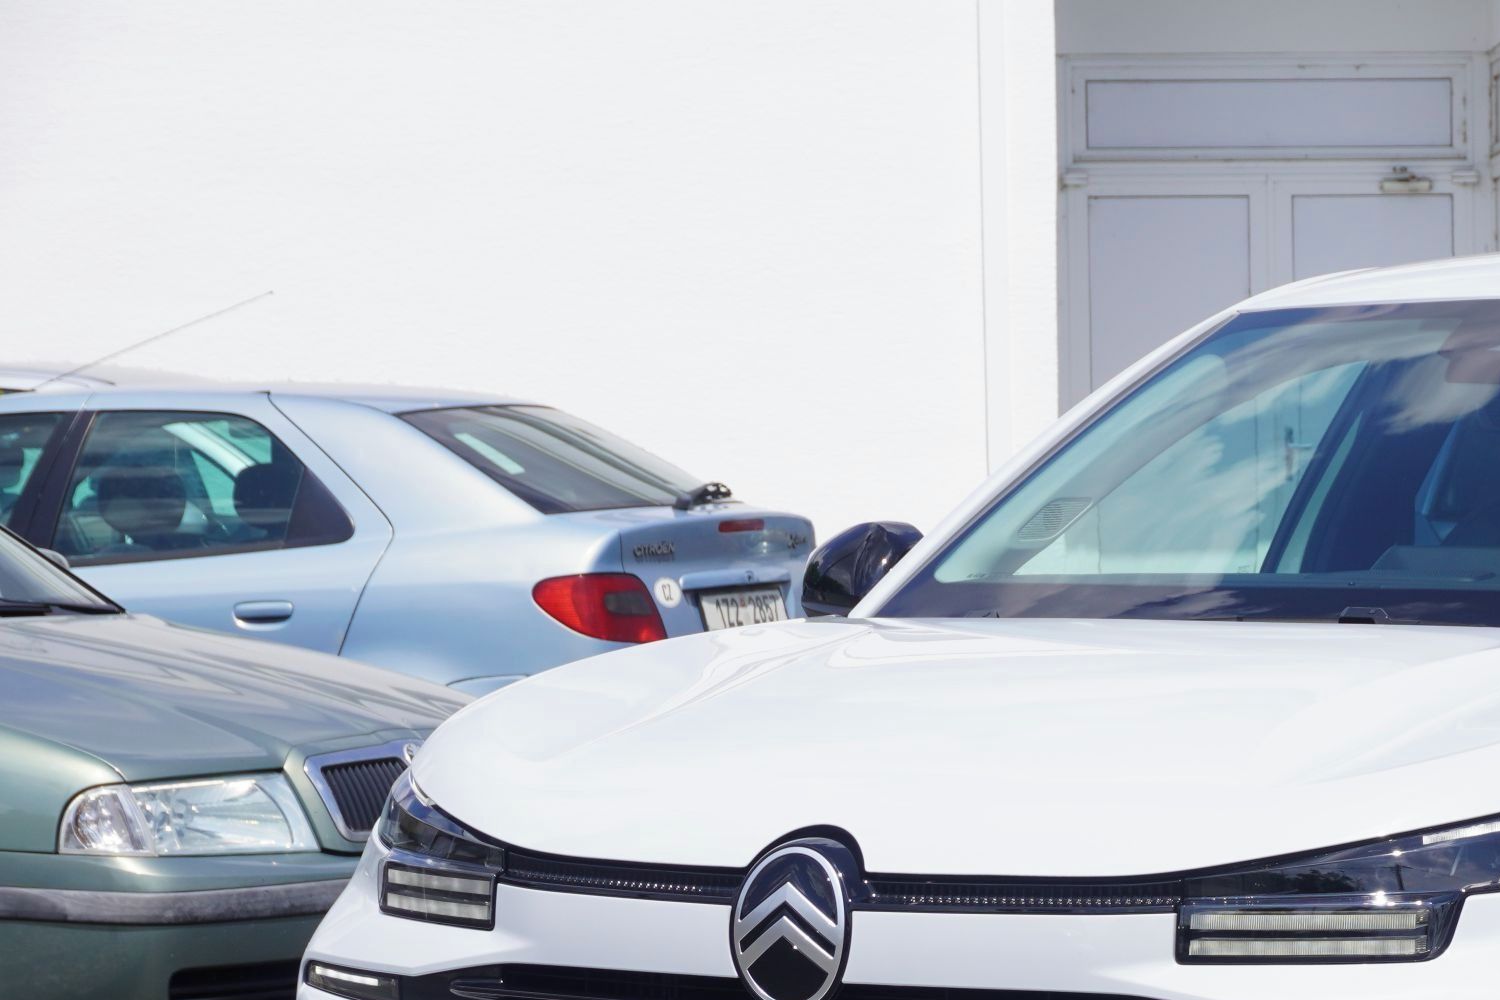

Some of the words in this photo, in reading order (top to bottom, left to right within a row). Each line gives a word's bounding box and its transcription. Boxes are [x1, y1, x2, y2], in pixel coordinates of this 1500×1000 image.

[633, 540, 675, 558] CITROËN
[661, 584, 674, 601] CZ
[716, 598, 744, 629] 1Z2
[752, 596, 780, 625] 2857
